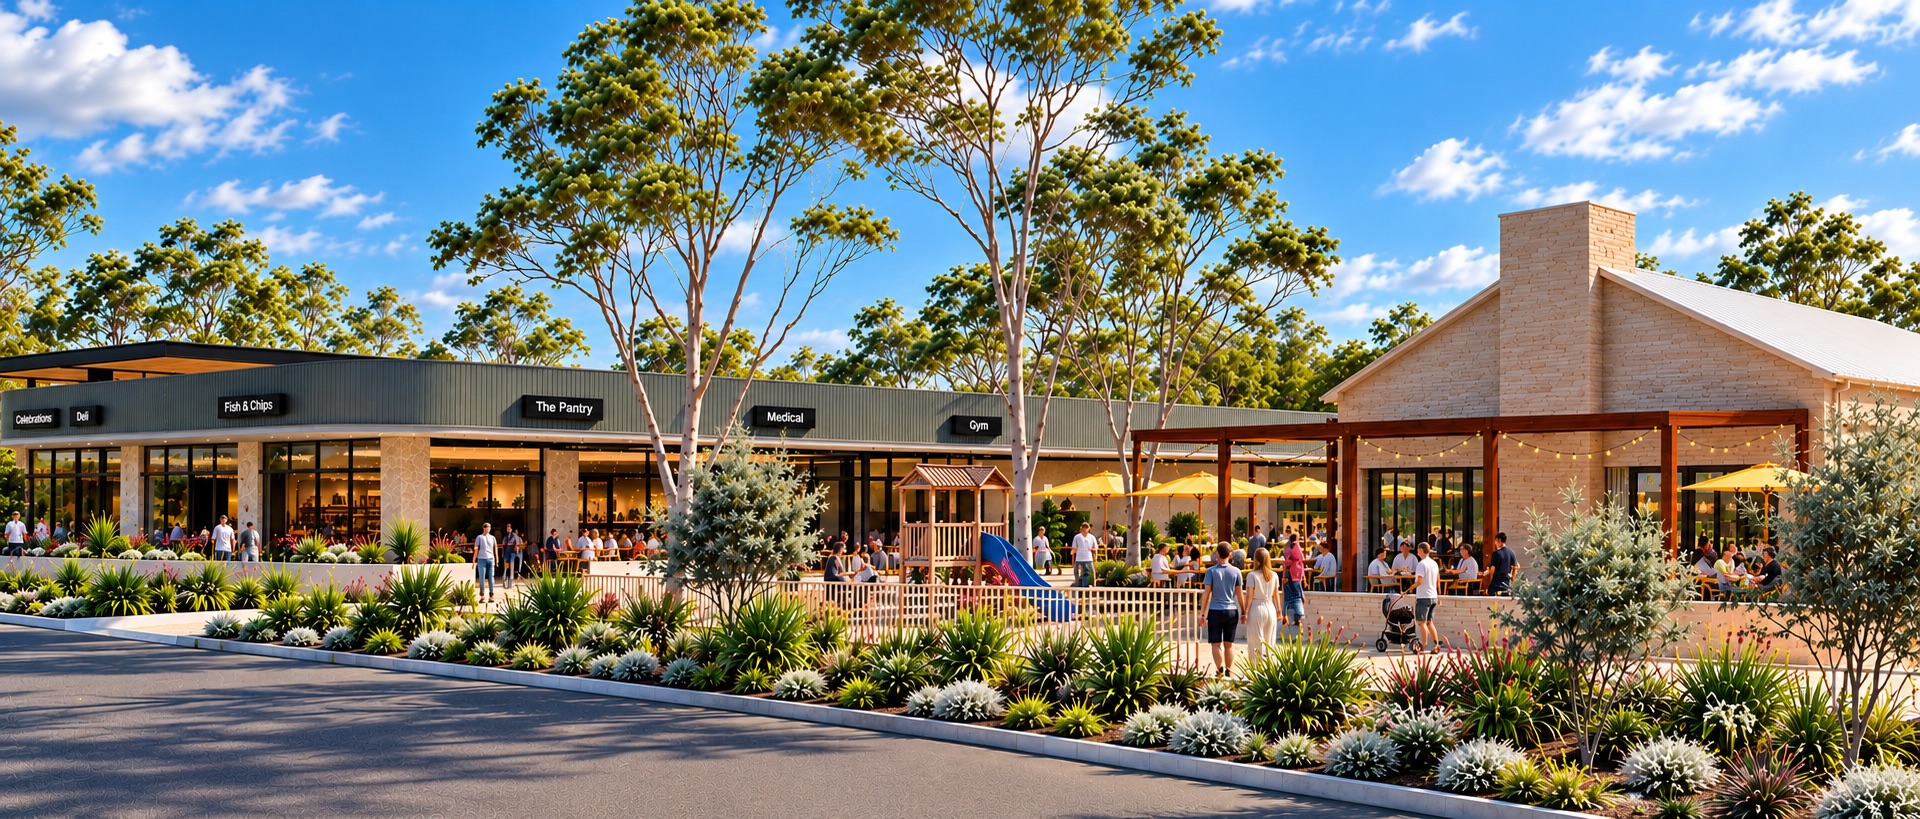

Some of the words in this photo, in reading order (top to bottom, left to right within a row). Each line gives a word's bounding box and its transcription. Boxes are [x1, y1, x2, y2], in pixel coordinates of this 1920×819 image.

[224, 401, 241, 412] Fish
[243, 401, 249, 412] &
[250, 399, 273, 413] Chips
[536, 400, 556, 412] The
[559, 402, 593, 416] Pantry
[15, 413, 52, 424] Celebrations
[76, 411, 89, 422] Deli
[767, 411, 804, 424] Medical
[969, 420, 989, 432] Gym
